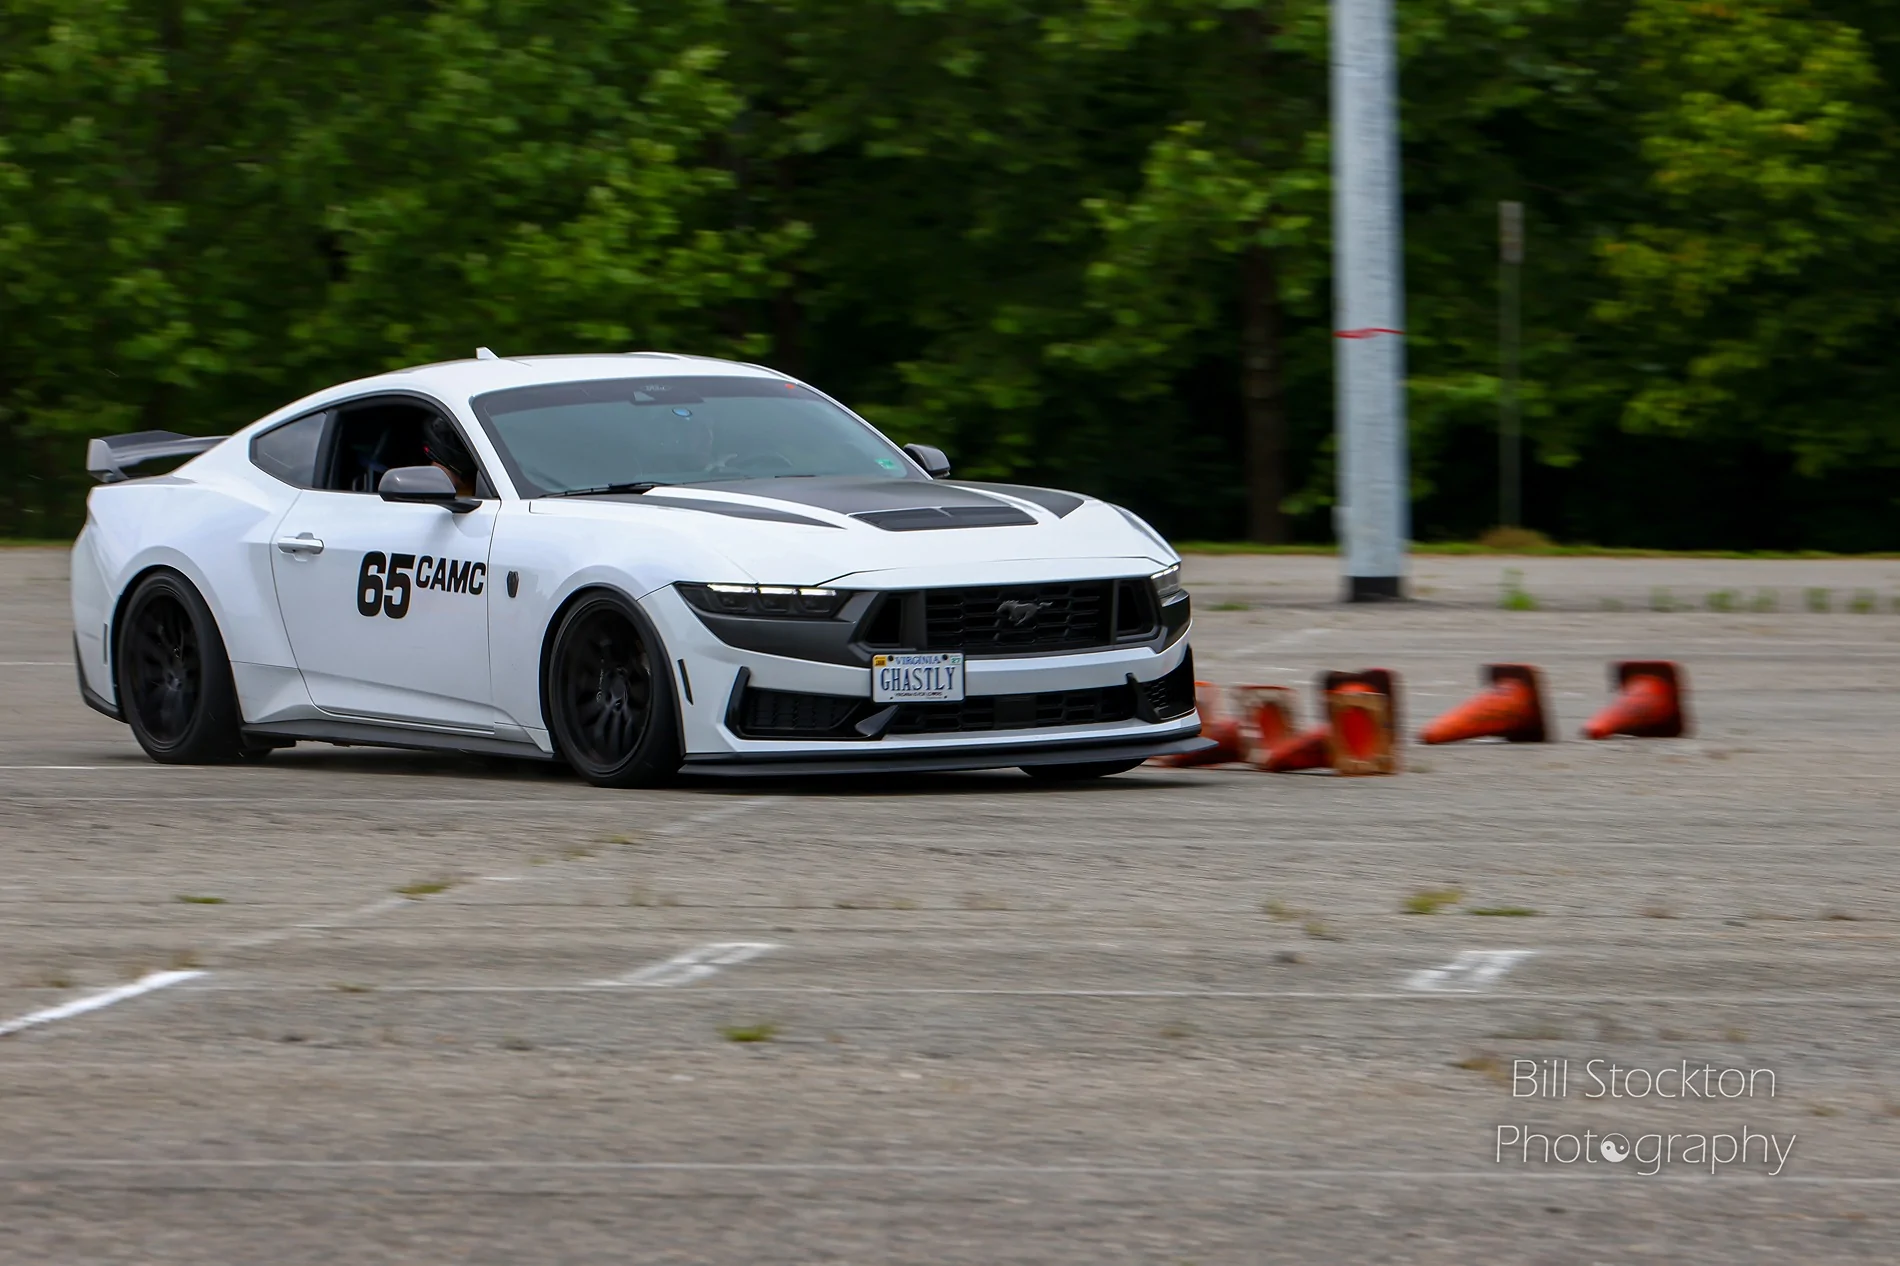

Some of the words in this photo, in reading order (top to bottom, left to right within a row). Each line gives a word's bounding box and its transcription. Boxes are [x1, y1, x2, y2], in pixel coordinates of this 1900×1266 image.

[357, 550, 416, 619] 65
[415, 555, 487, 595] CAMC
[896, 656, 941, 665] VIRGINIA
[881, 666, 956, 691] GHASTLY
